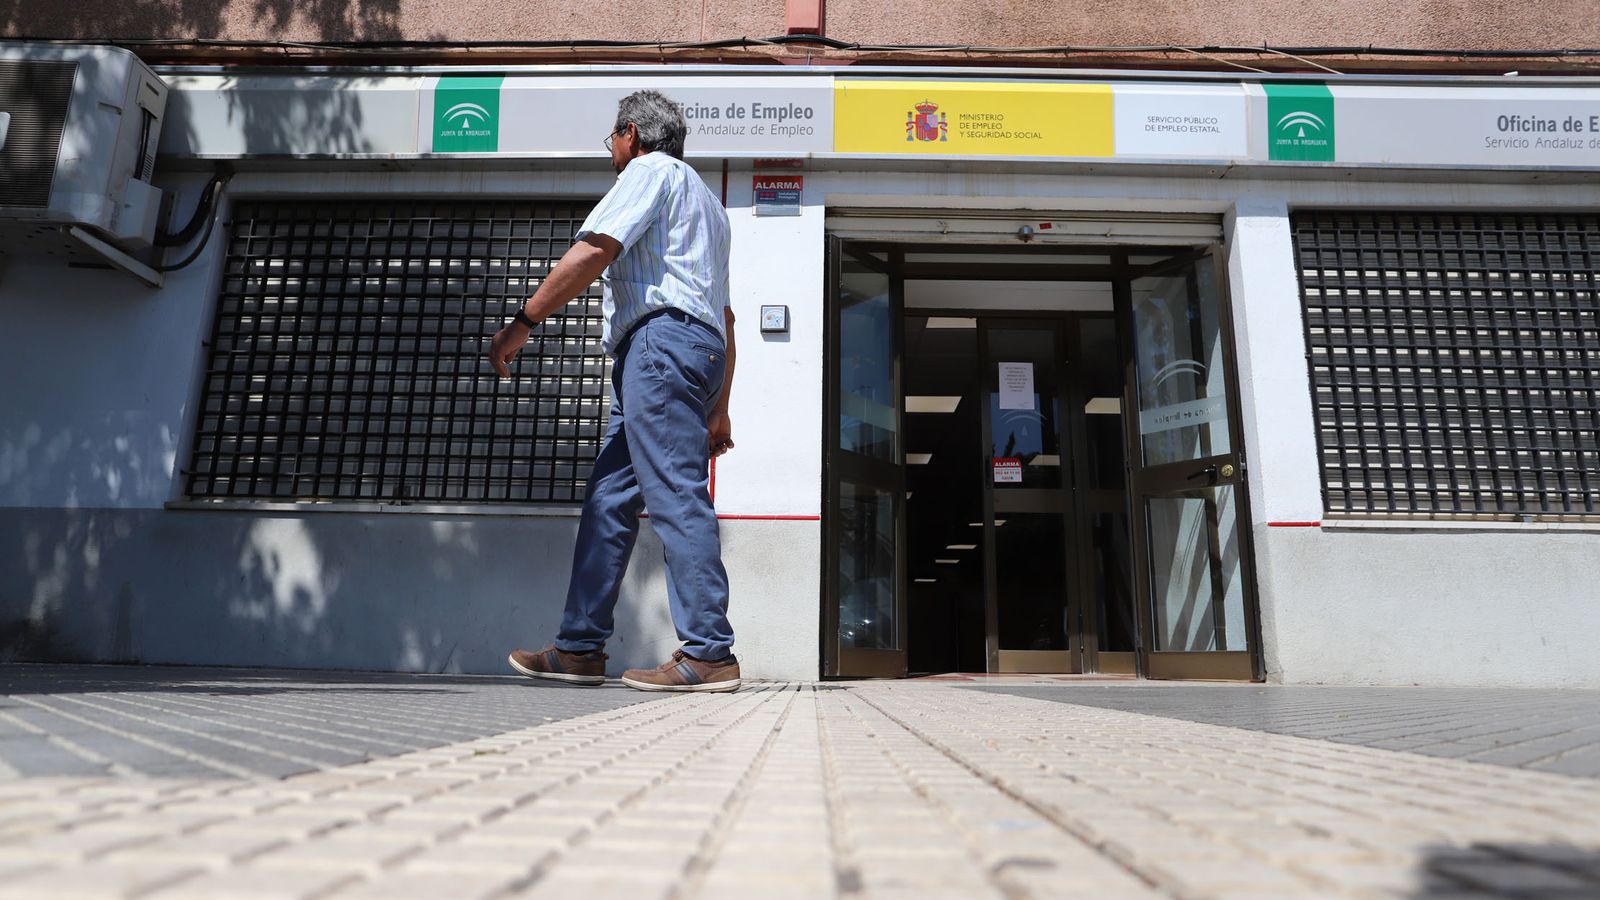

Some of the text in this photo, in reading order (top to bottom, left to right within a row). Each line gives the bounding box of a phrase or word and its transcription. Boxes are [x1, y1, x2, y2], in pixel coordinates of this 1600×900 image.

[676, 102, 813, 122] icina de Empleo
[959, 113, 1004, 121] MINISTERIO
[1147, 115, 1218, 124] SERVICIO PÚBLICO
[972, 122, 1003, 130] EMPLEO
[1497, 114, 1557, 132] Oficina
[1563, 115, 1583, 132] de
[697, 124, 745, 136] Andaluz
[750, 124, 765, 136] de
[771, 124, 814, 138] Empleo
[966, 131, 1012, 139] SEGURIDAD
[1485, 136, 1530, 149] Servicio
[1535, 137, 1584, 149] Andaluz
[755, 181, 800, 189] ALARMA
